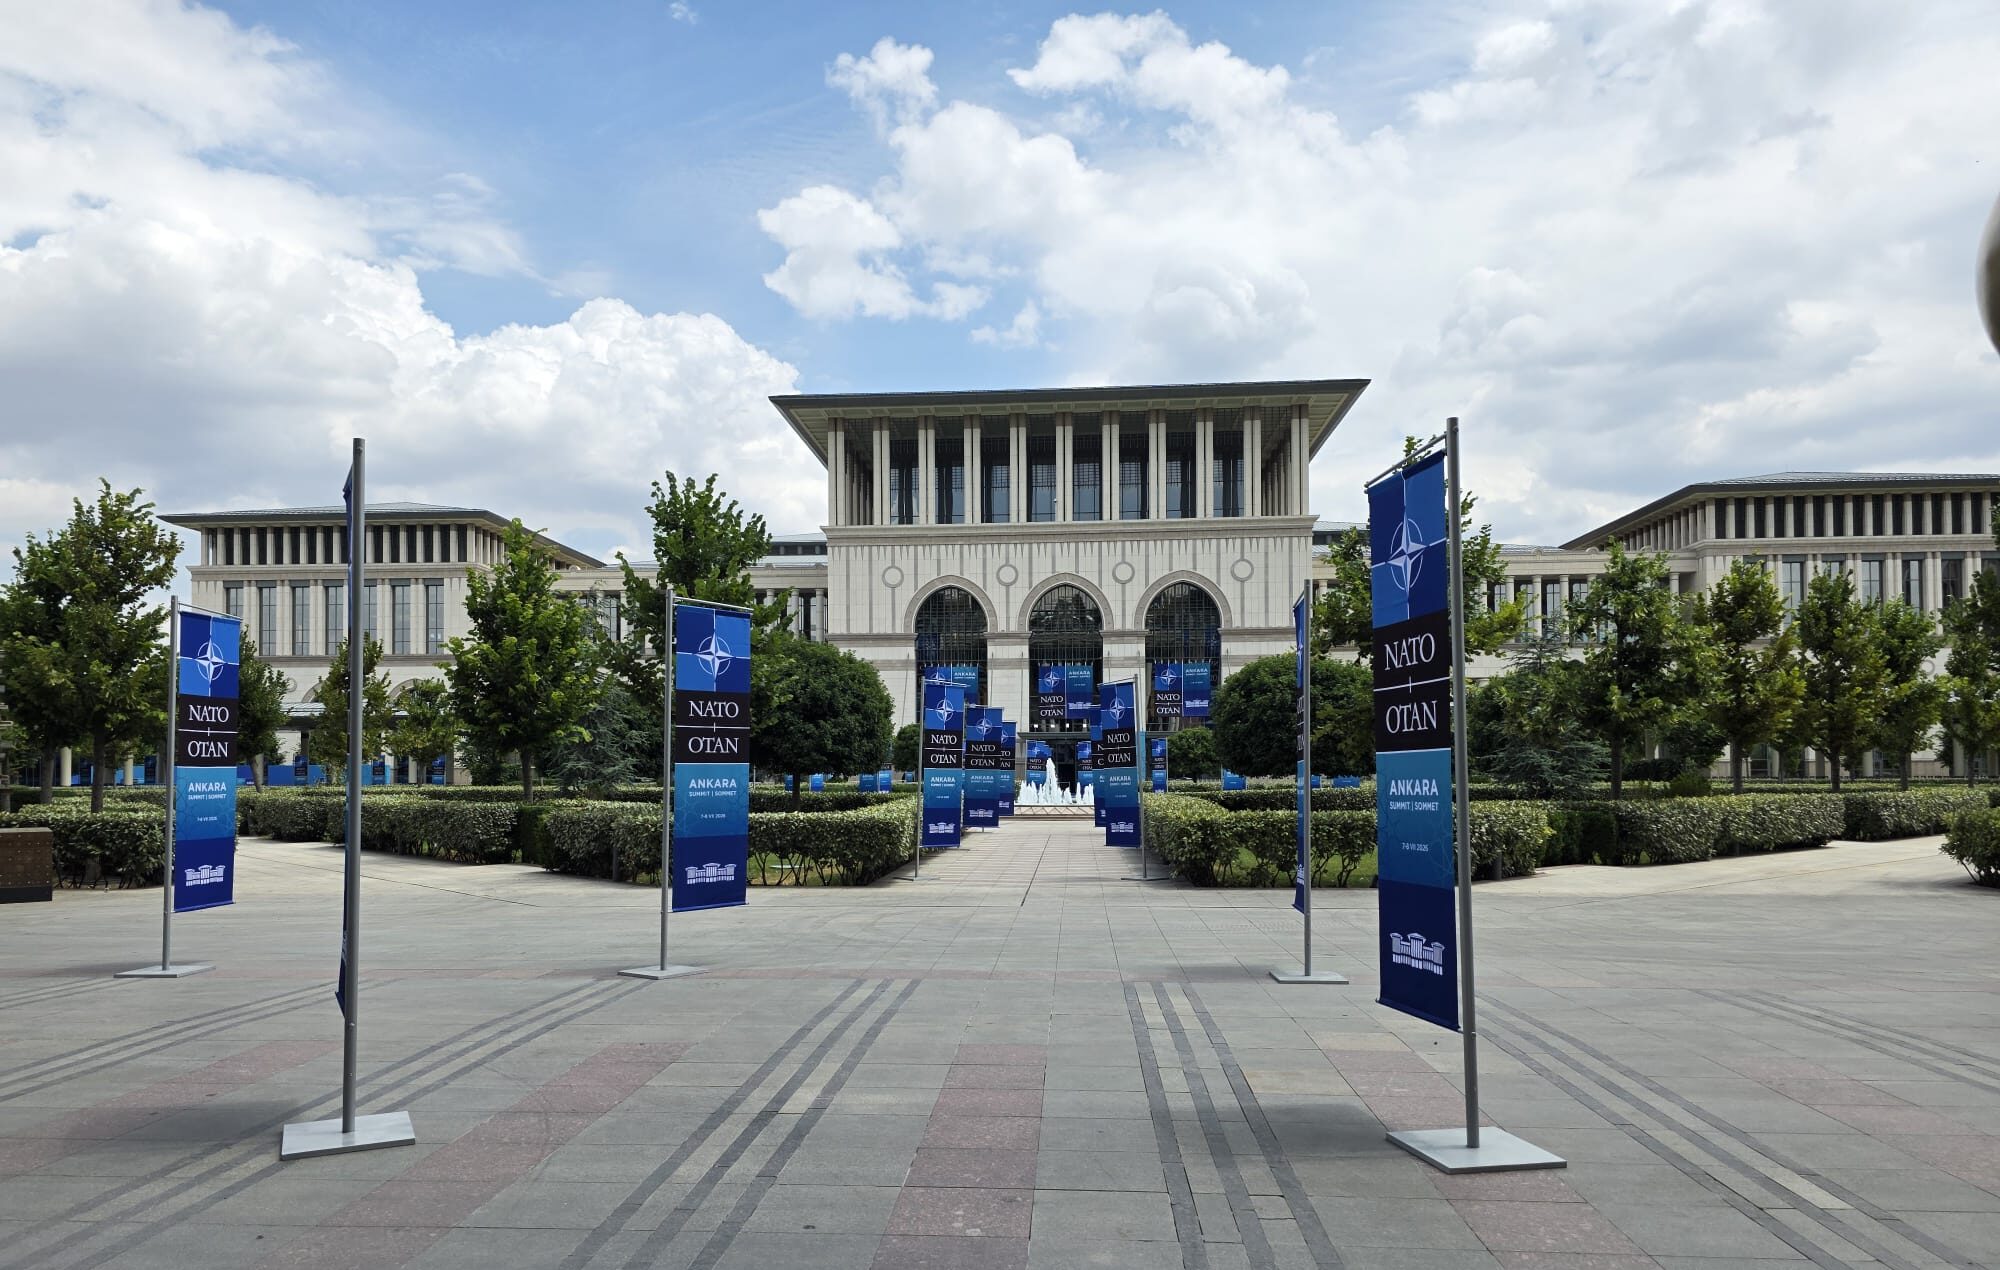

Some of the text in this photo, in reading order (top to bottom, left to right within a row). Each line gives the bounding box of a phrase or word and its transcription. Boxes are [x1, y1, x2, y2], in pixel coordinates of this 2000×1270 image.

[1384, 633, 1436, 670] NATO
[188, 704, 230, 722] NATO
[688, 700, 739, 718] NATO
[1040, 708, 1064, 716] OTAN
[1386, 700, 1438, 734] OTAN
[931, 734, 958, 744] NATO
[1108, 733, 1130, 744] NATO
[188, 740, 228, 758] OTAN
[688, 736, 739, 754] OTAN
[930, 754, 957, 764] OTAN
[1108, 753, 1131, 762] OTAN
[188, 782, 227, 792] ANKARA
[689, 778, 737, 788] ANKARA
[1390, 778, 1438, 796] ANKARA
[1390, 801, 1439, 811] SUMMIT SOMMET
